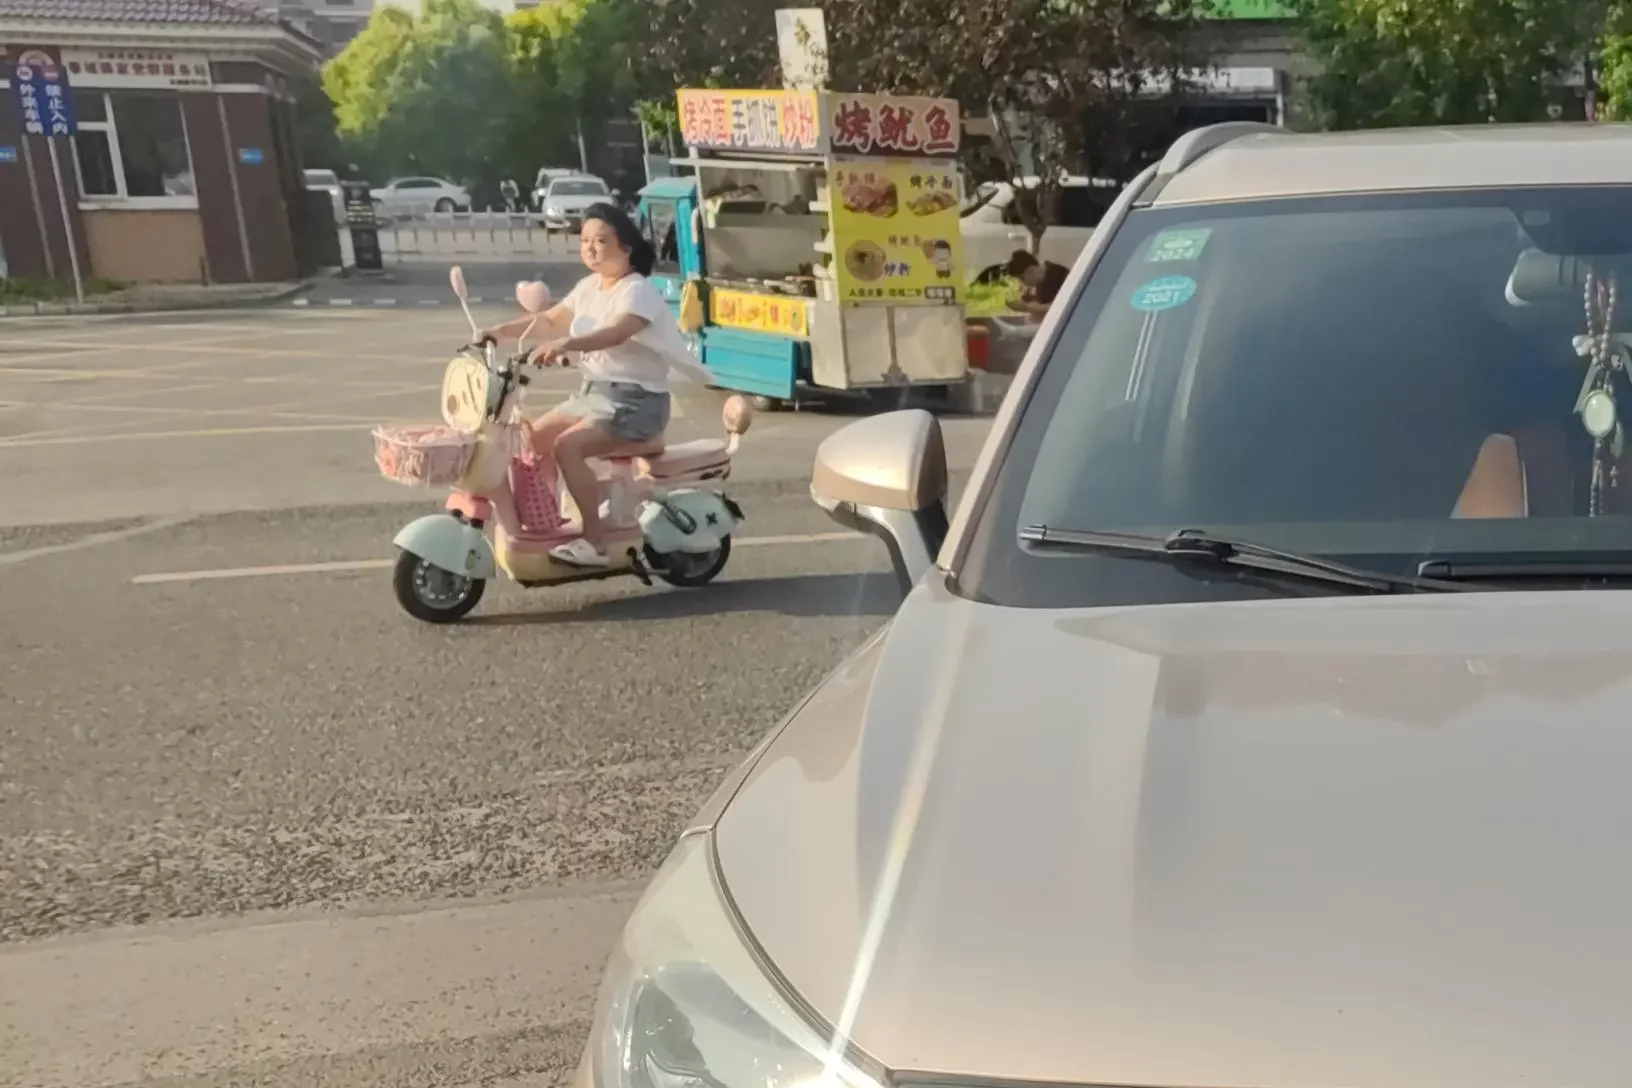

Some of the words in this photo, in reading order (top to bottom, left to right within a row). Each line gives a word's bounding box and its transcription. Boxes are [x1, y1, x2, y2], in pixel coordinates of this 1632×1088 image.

[45, 83, 68, 134] 禁止入内
[833, 99, 958, 153] 烤鱿鱼
